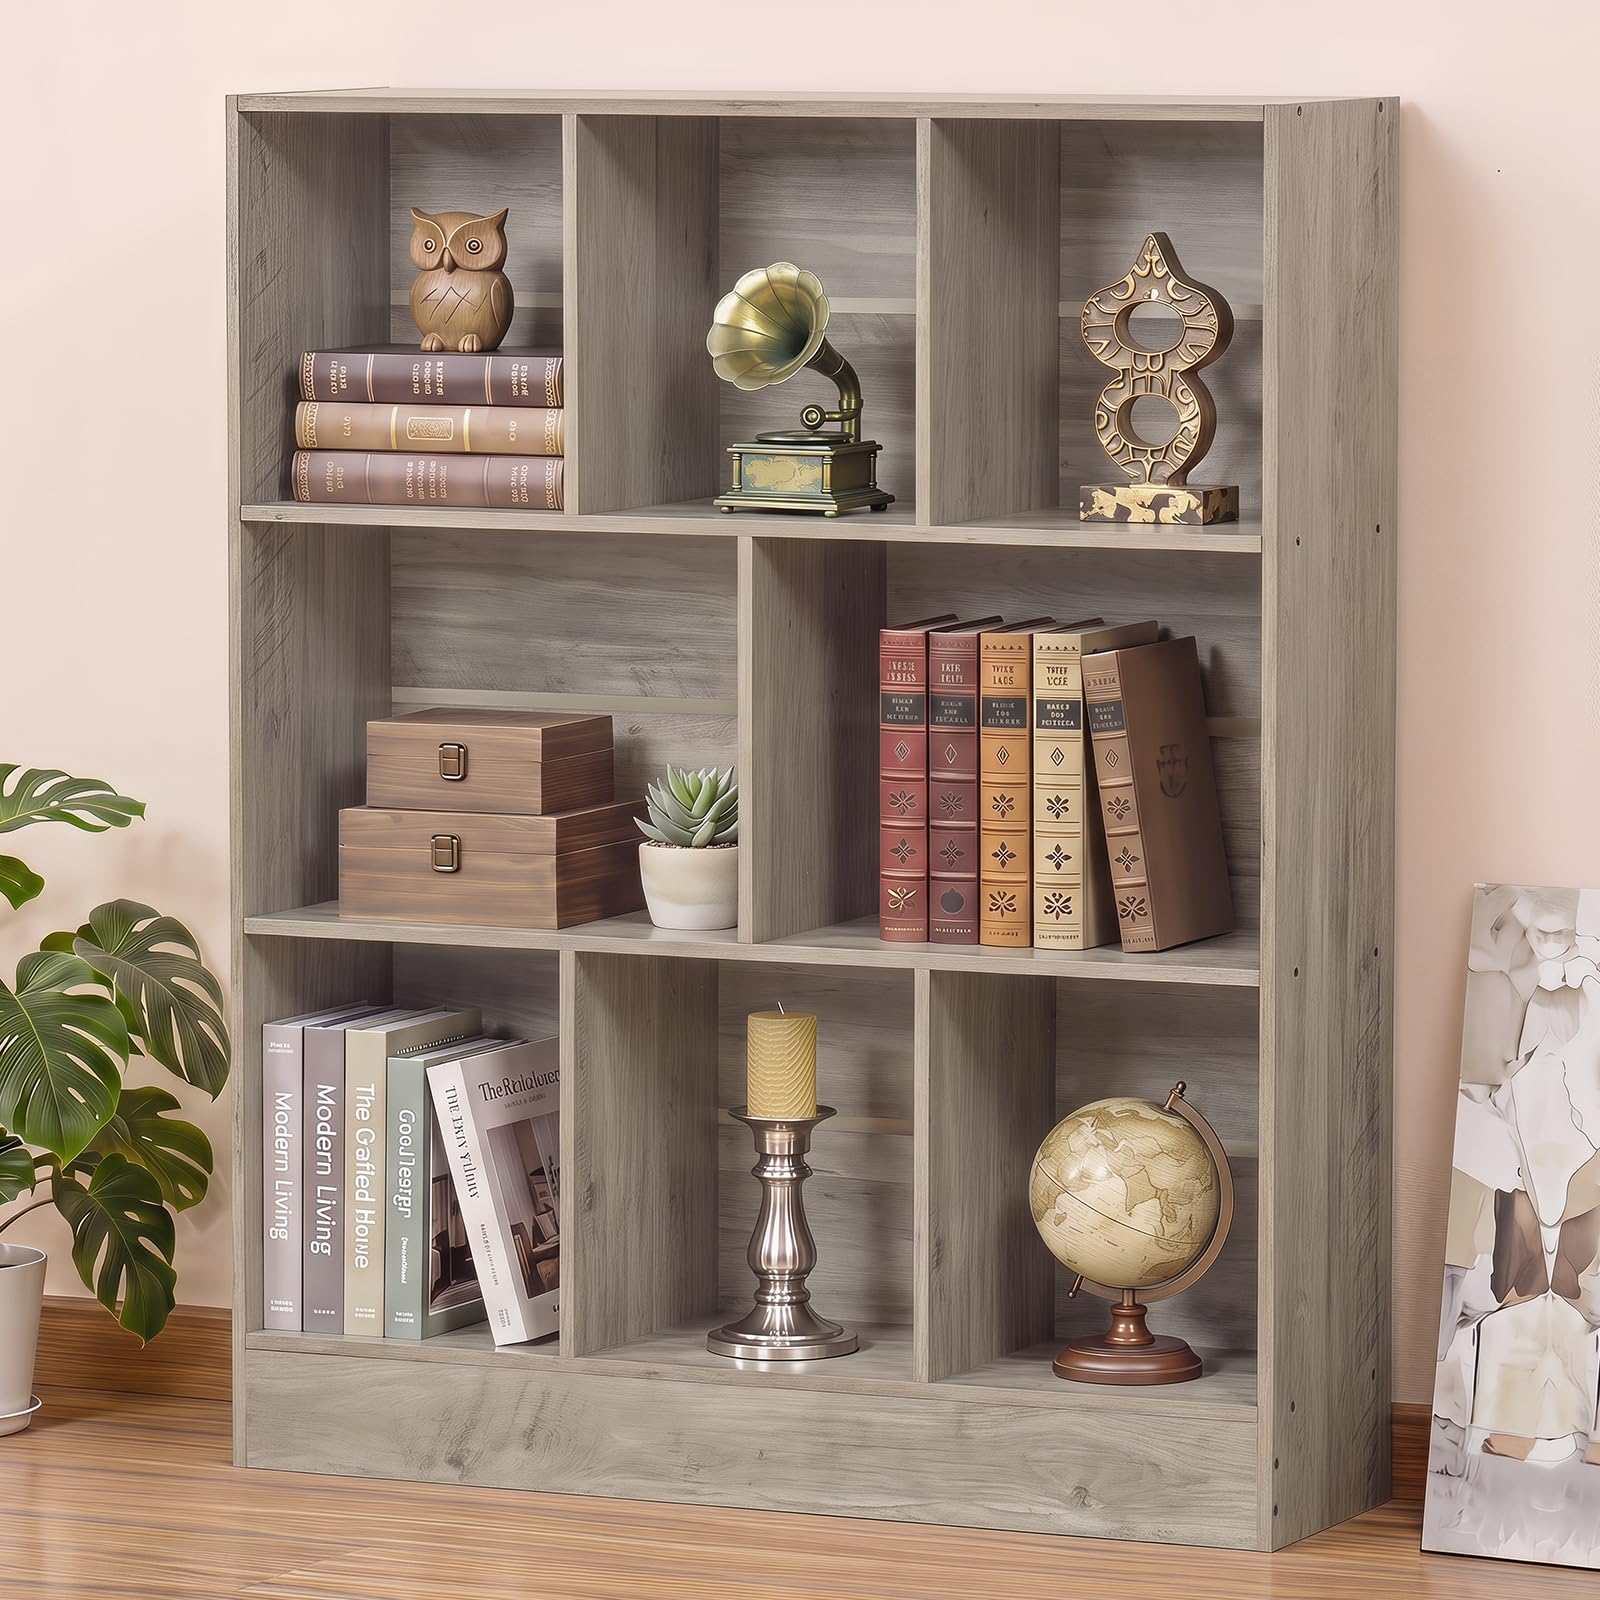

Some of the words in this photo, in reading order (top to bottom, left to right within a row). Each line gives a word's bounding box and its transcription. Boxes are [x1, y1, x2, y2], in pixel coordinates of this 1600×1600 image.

[354, 1083, 376, 1122] The
[478, 1081, 503, 1102] The
[273, 1091, 293, 1173] Modern
[315, 1083, 337, 1176] Modern
[269, 1180, 293, 1241] Living
[310, 1186, 338, 1256] Living
